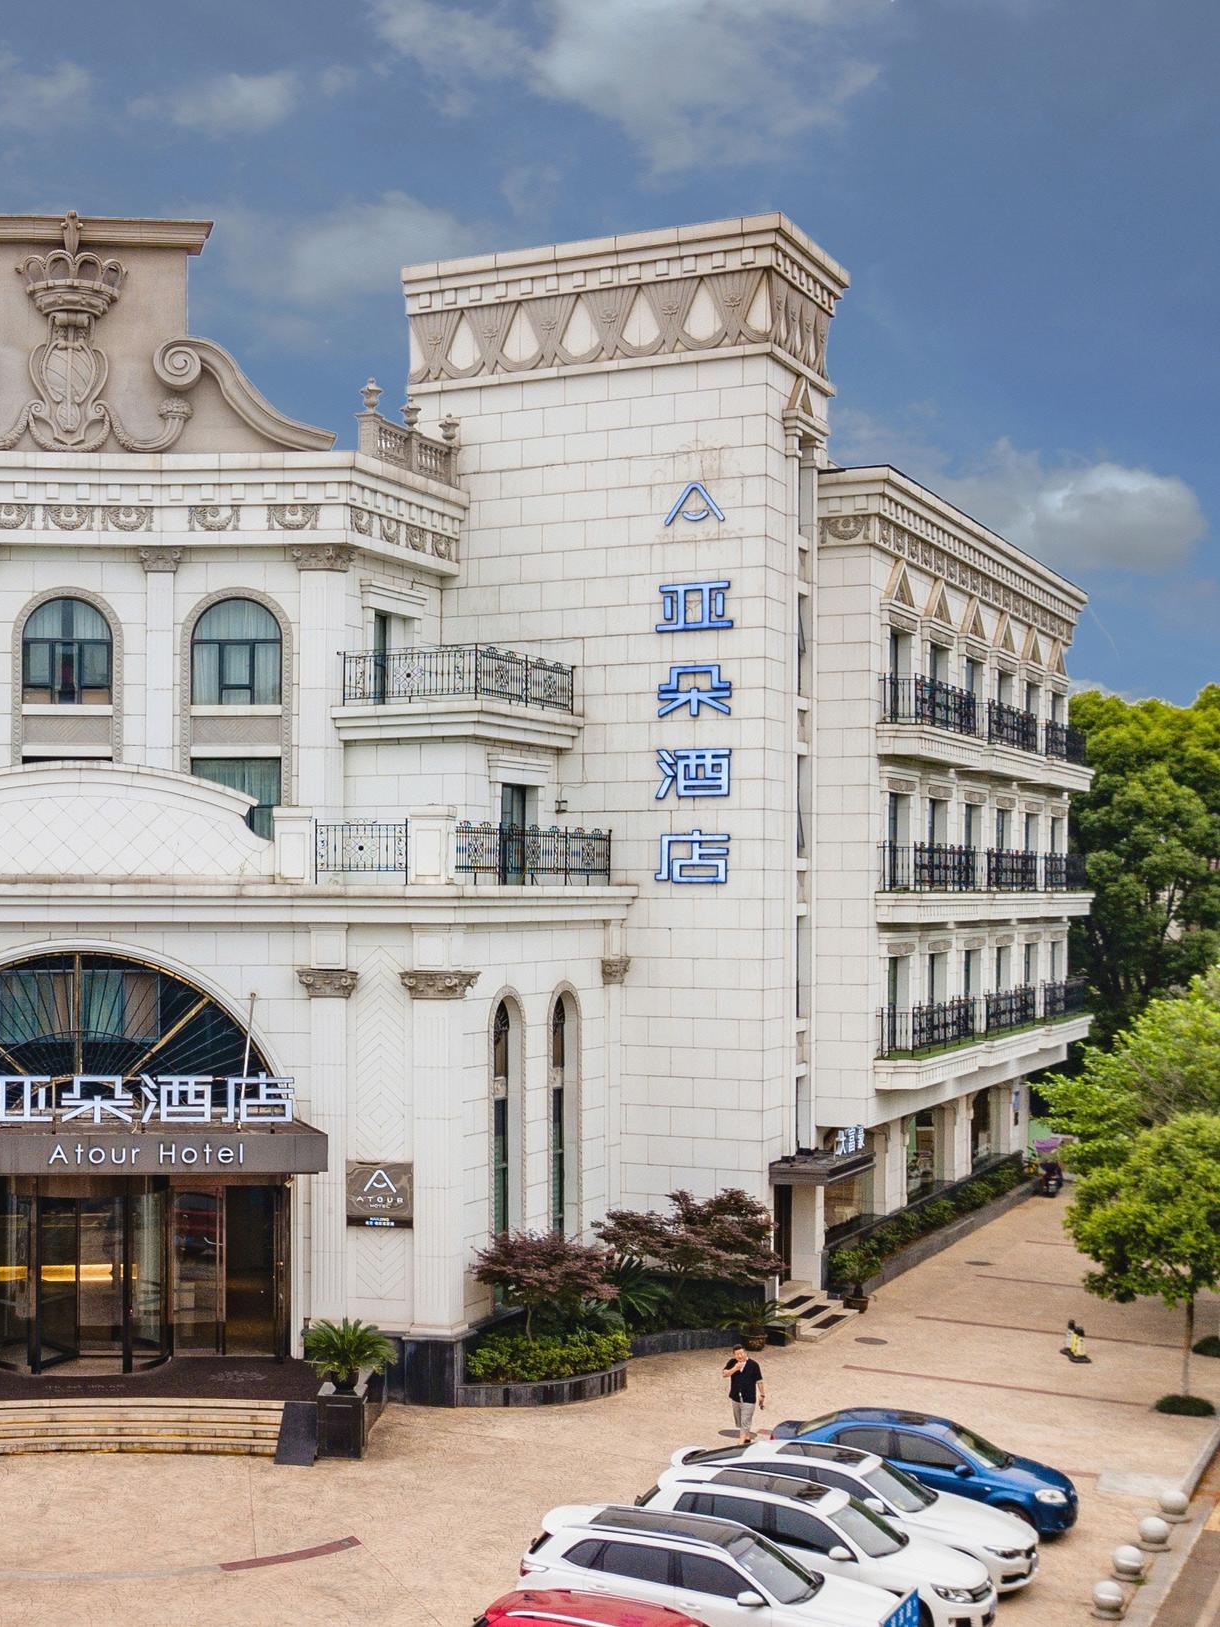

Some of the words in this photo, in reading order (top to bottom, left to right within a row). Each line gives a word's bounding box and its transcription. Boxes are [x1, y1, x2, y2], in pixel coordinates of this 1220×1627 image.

[655, 580, 734, 884] 亚朵酒店
[48, 1143, 141, 1165] Atour
[159, 1143, 245, 1165] Hotel
[356, 1195, 404, 1204] ATOUR
